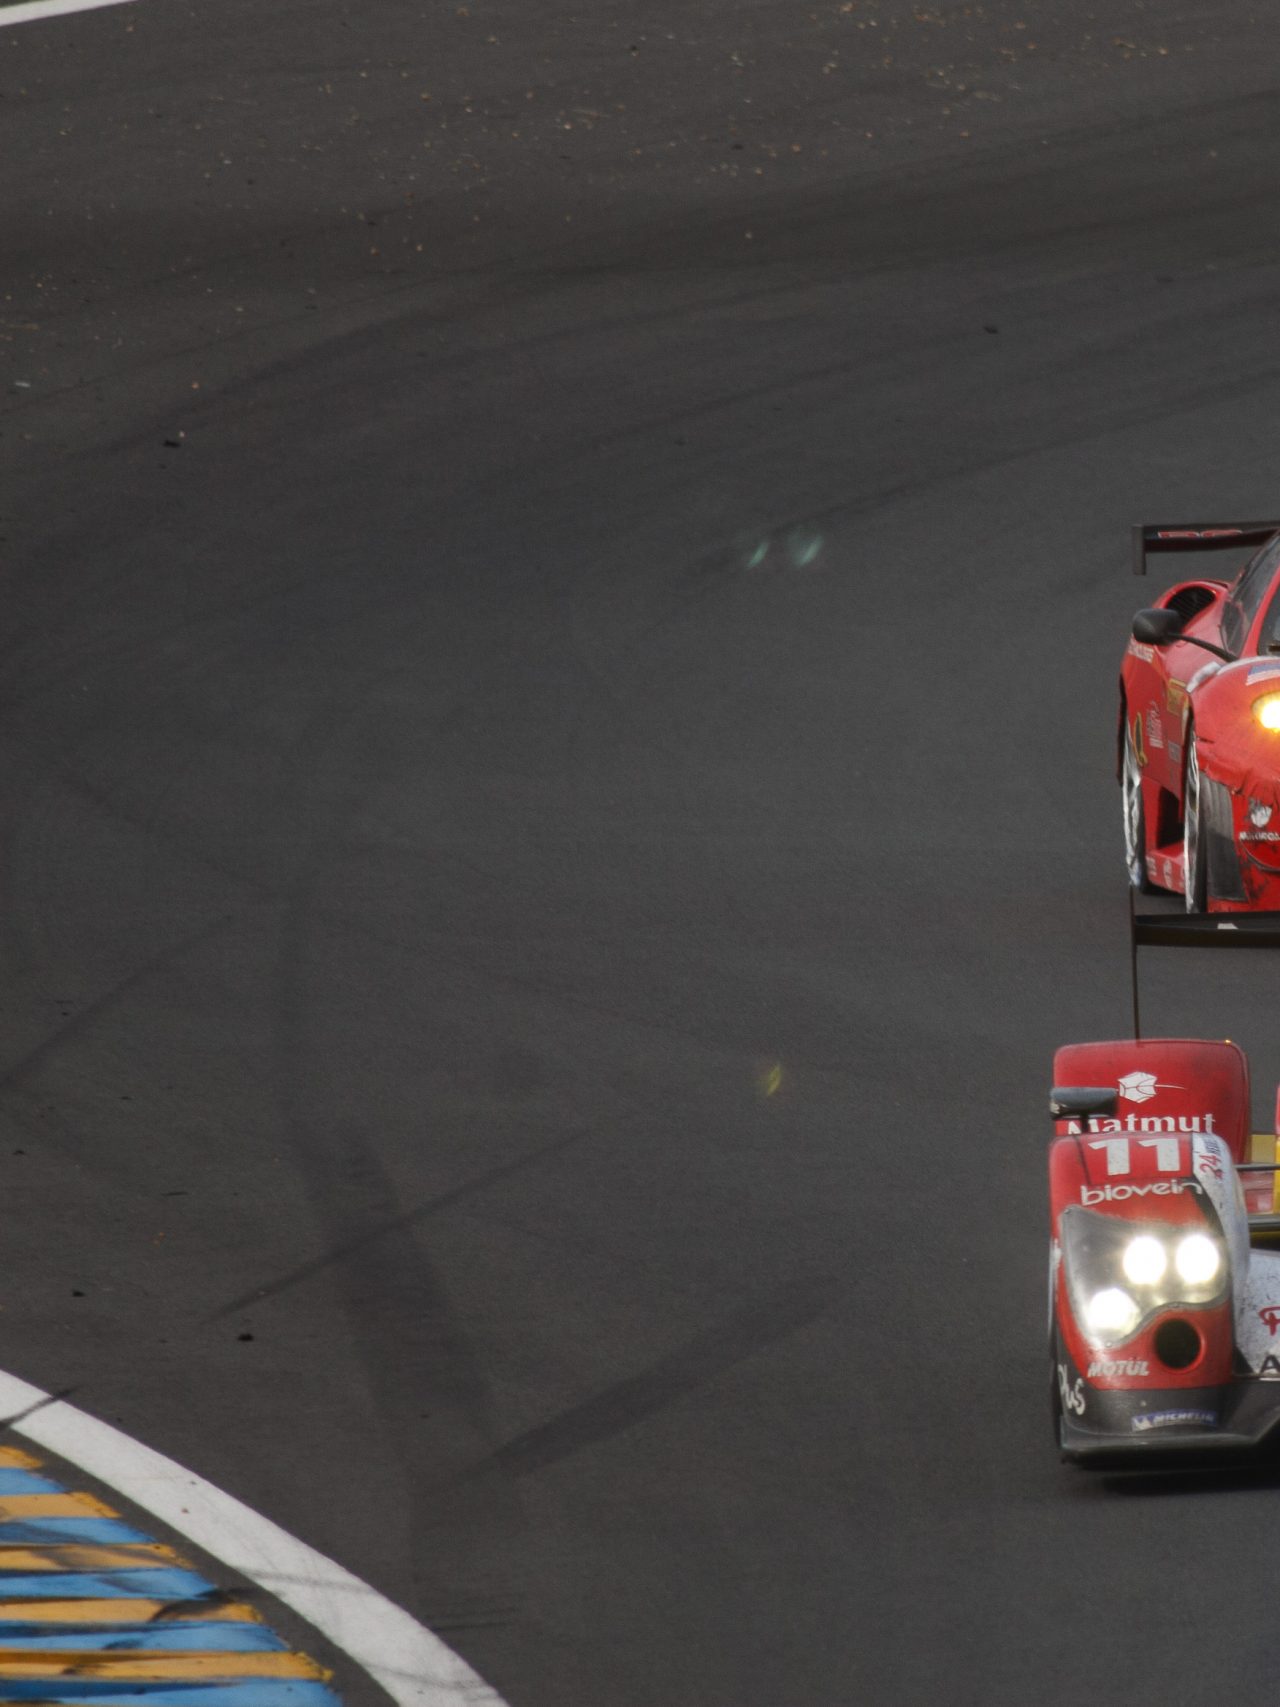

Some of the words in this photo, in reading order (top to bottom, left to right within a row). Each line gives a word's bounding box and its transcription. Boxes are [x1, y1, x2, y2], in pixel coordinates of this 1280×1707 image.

[1087, 1138, 1181, 1176] 11
[1080, 1179, 1203, 1207] biovein
[1086, 1360, 1150, 1378] MOTUL
[1153, 1410, 1216, 1424] MICHELIN
